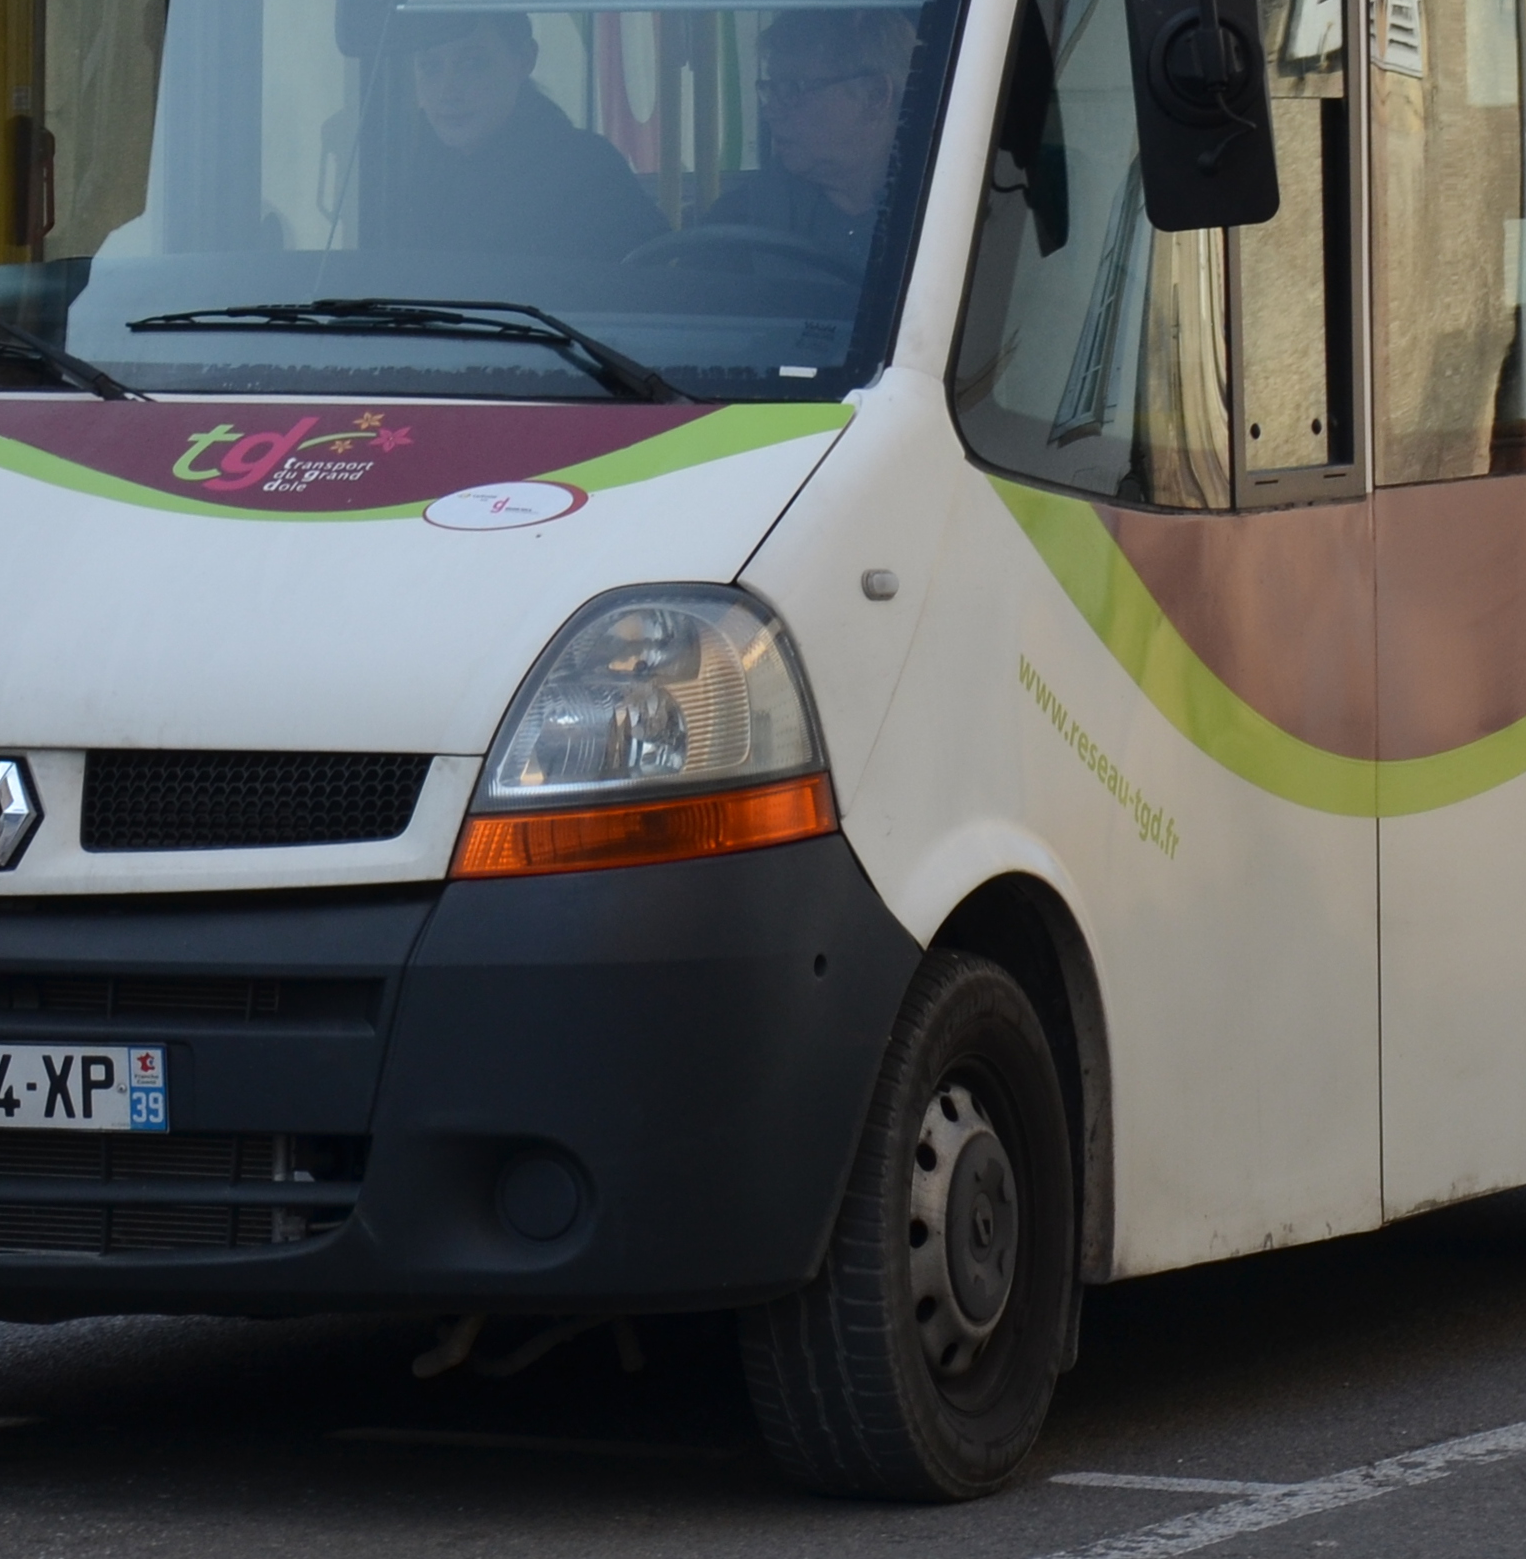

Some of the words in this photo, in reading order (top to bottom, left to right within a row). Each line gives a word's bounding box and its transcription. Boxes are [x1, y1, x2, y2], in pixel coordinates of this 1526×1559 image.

[283, 457, 374, 472] transport
[273, 470, 297, 480] du
[303, 469, 364, 482] grand
[262, 479, 307, 492] dole
[1018, 654, 1181, 860] www.reseau-tgd.fr
[132, 1092, 165, 1123] 39
